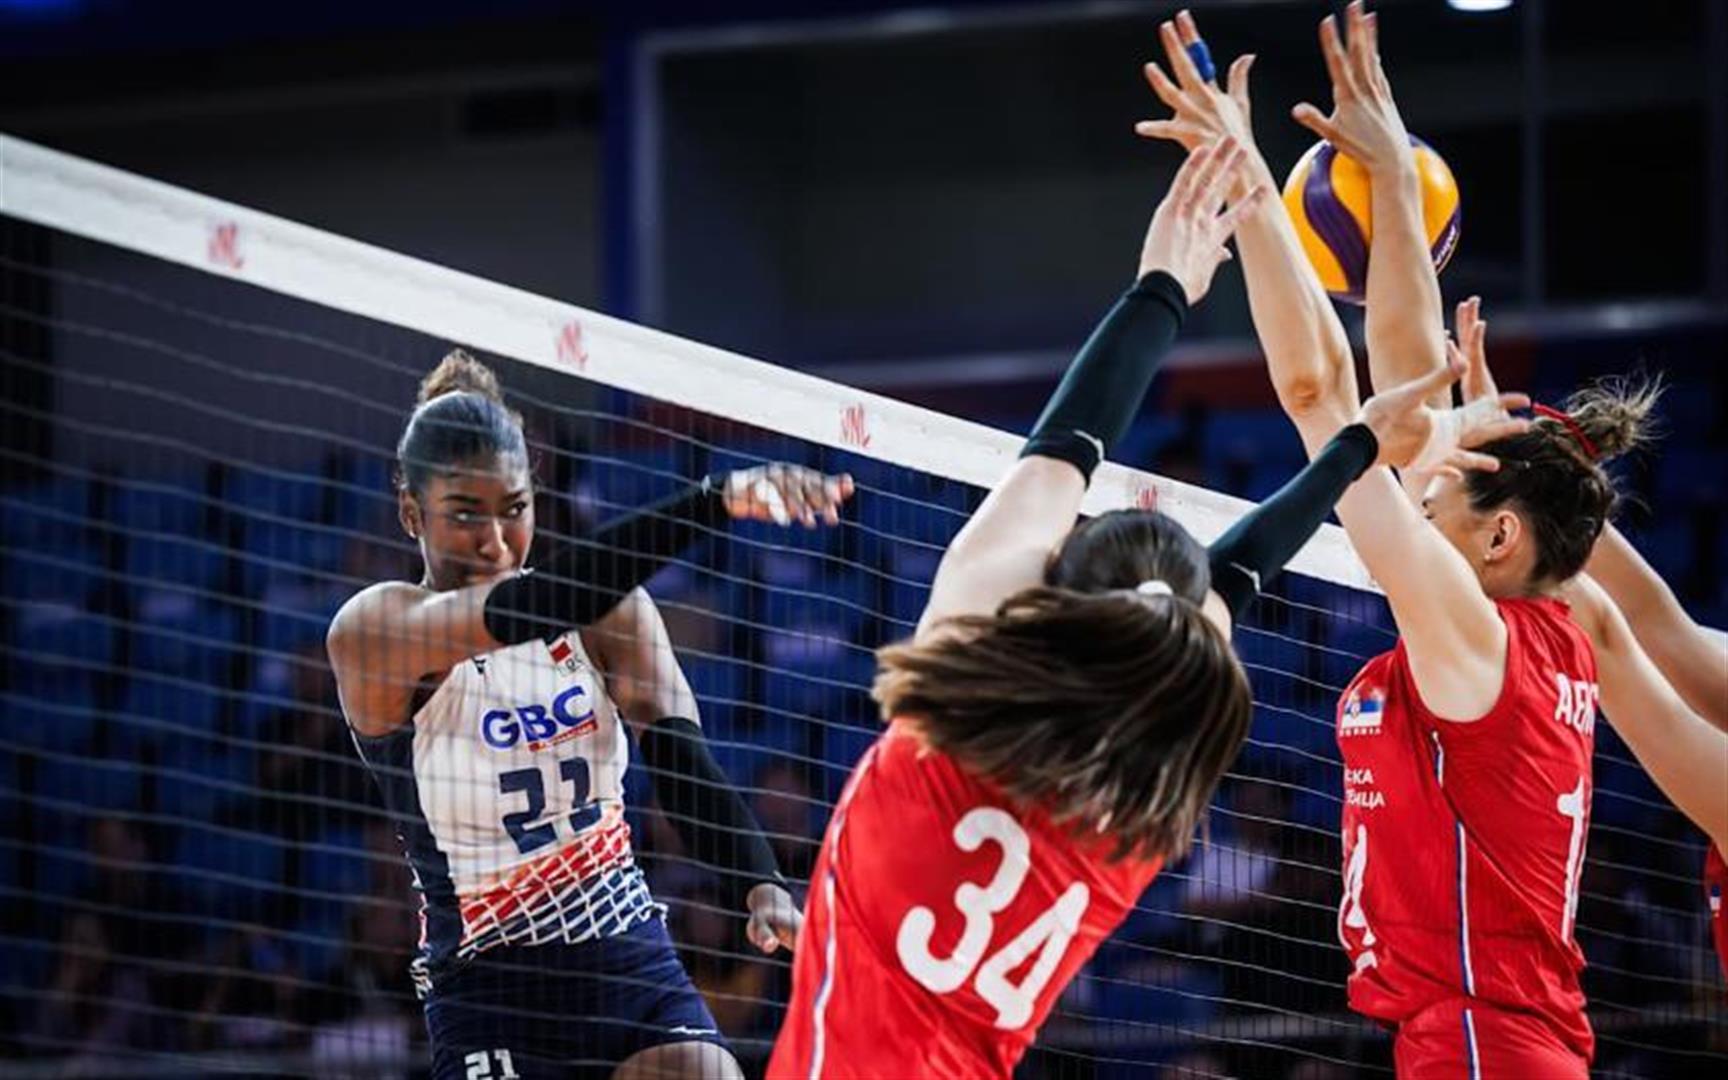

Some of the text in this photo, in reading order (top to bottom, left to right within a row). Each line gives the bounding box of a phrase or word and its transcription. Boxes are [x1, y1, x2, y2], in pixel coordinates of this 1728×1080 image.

[482, 685, 594, 748] GBC
[499, 757, 602, 854] 21
[896, 806, 1090, 1030] 34
[464, 1049, 519, 1080] 21
